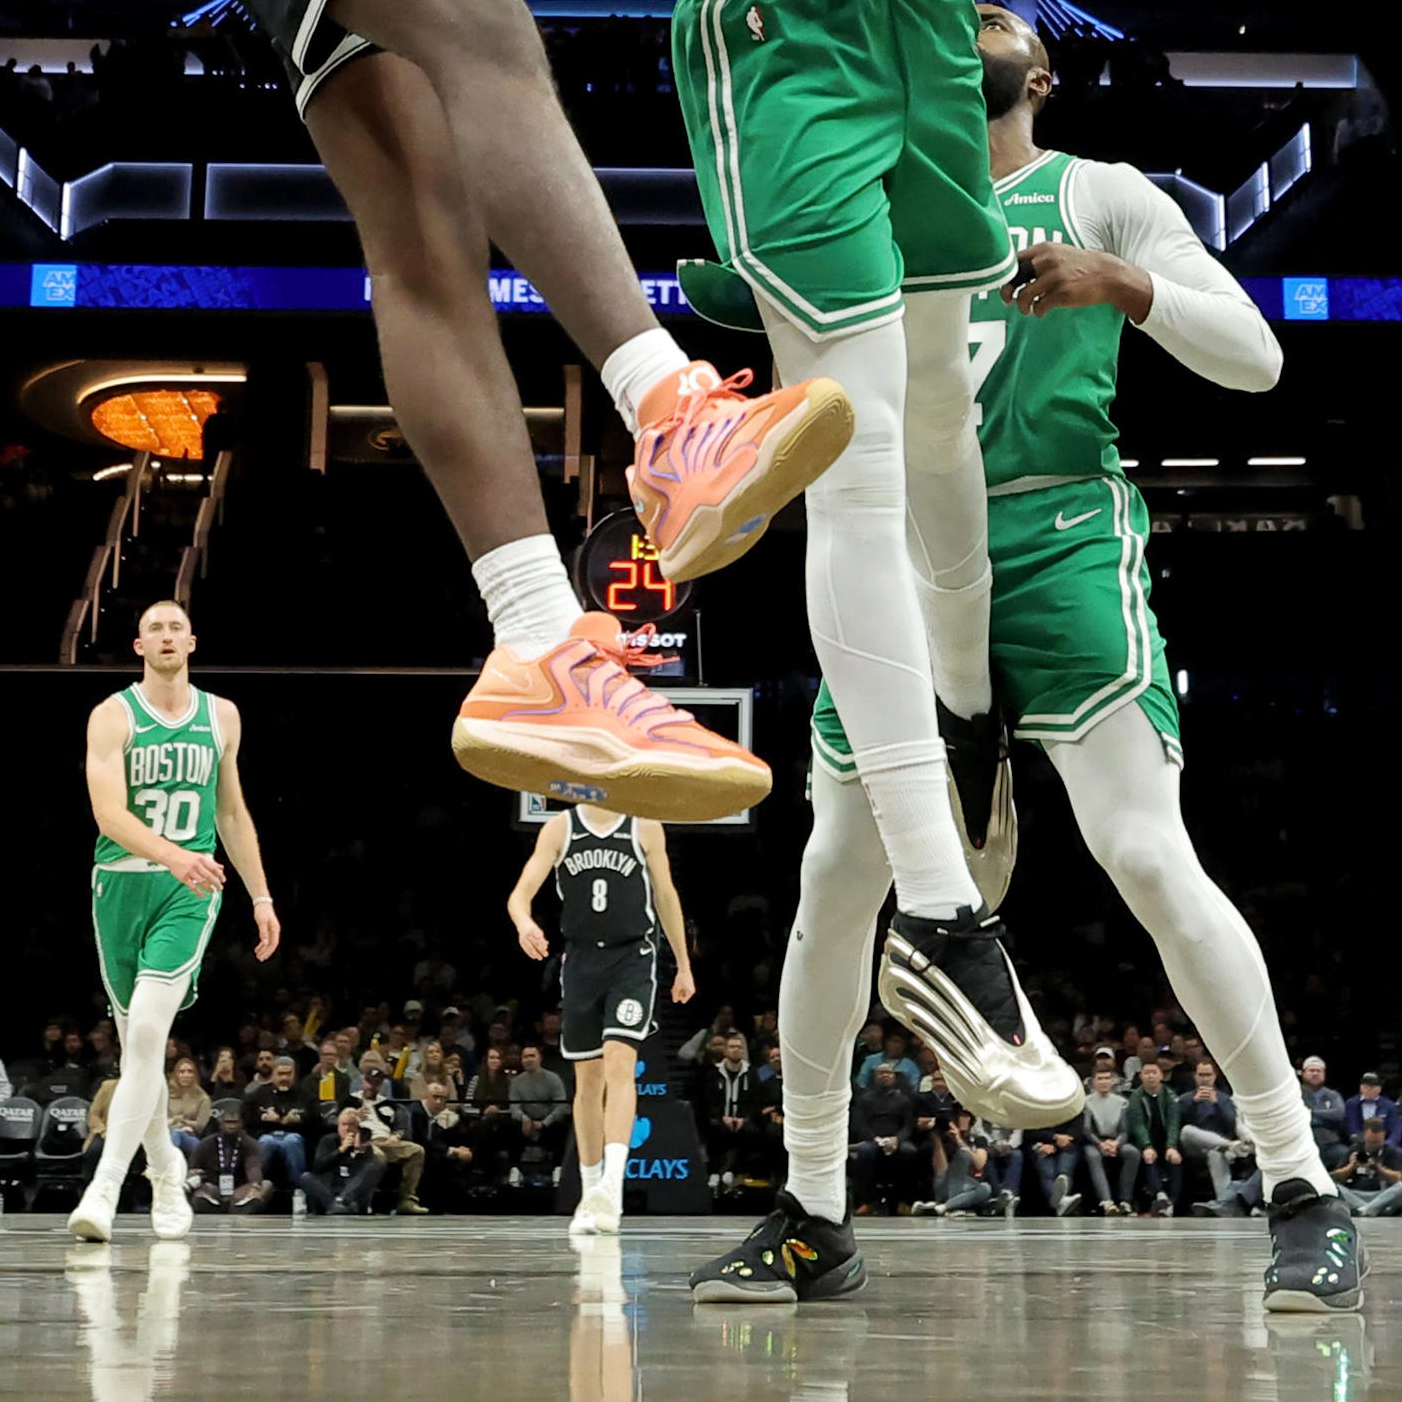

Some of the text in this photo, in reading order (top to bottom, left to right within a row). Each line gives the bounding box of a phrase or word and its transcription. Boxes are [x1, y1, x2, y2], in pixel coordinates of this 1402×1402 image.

[1004, 192, 1055, 206] Amica
[608, 561, 675, 612] 24
[616, 632, 687, 648] TISSOT
[130, 741, 215, 787] BOSTON
[134, 788, 201, 842] 30
[564, 848, 637, 878] BROOKLYN
[592, 879, 608, 913] 8
[636, 1083, 667, 1095] LAYS
